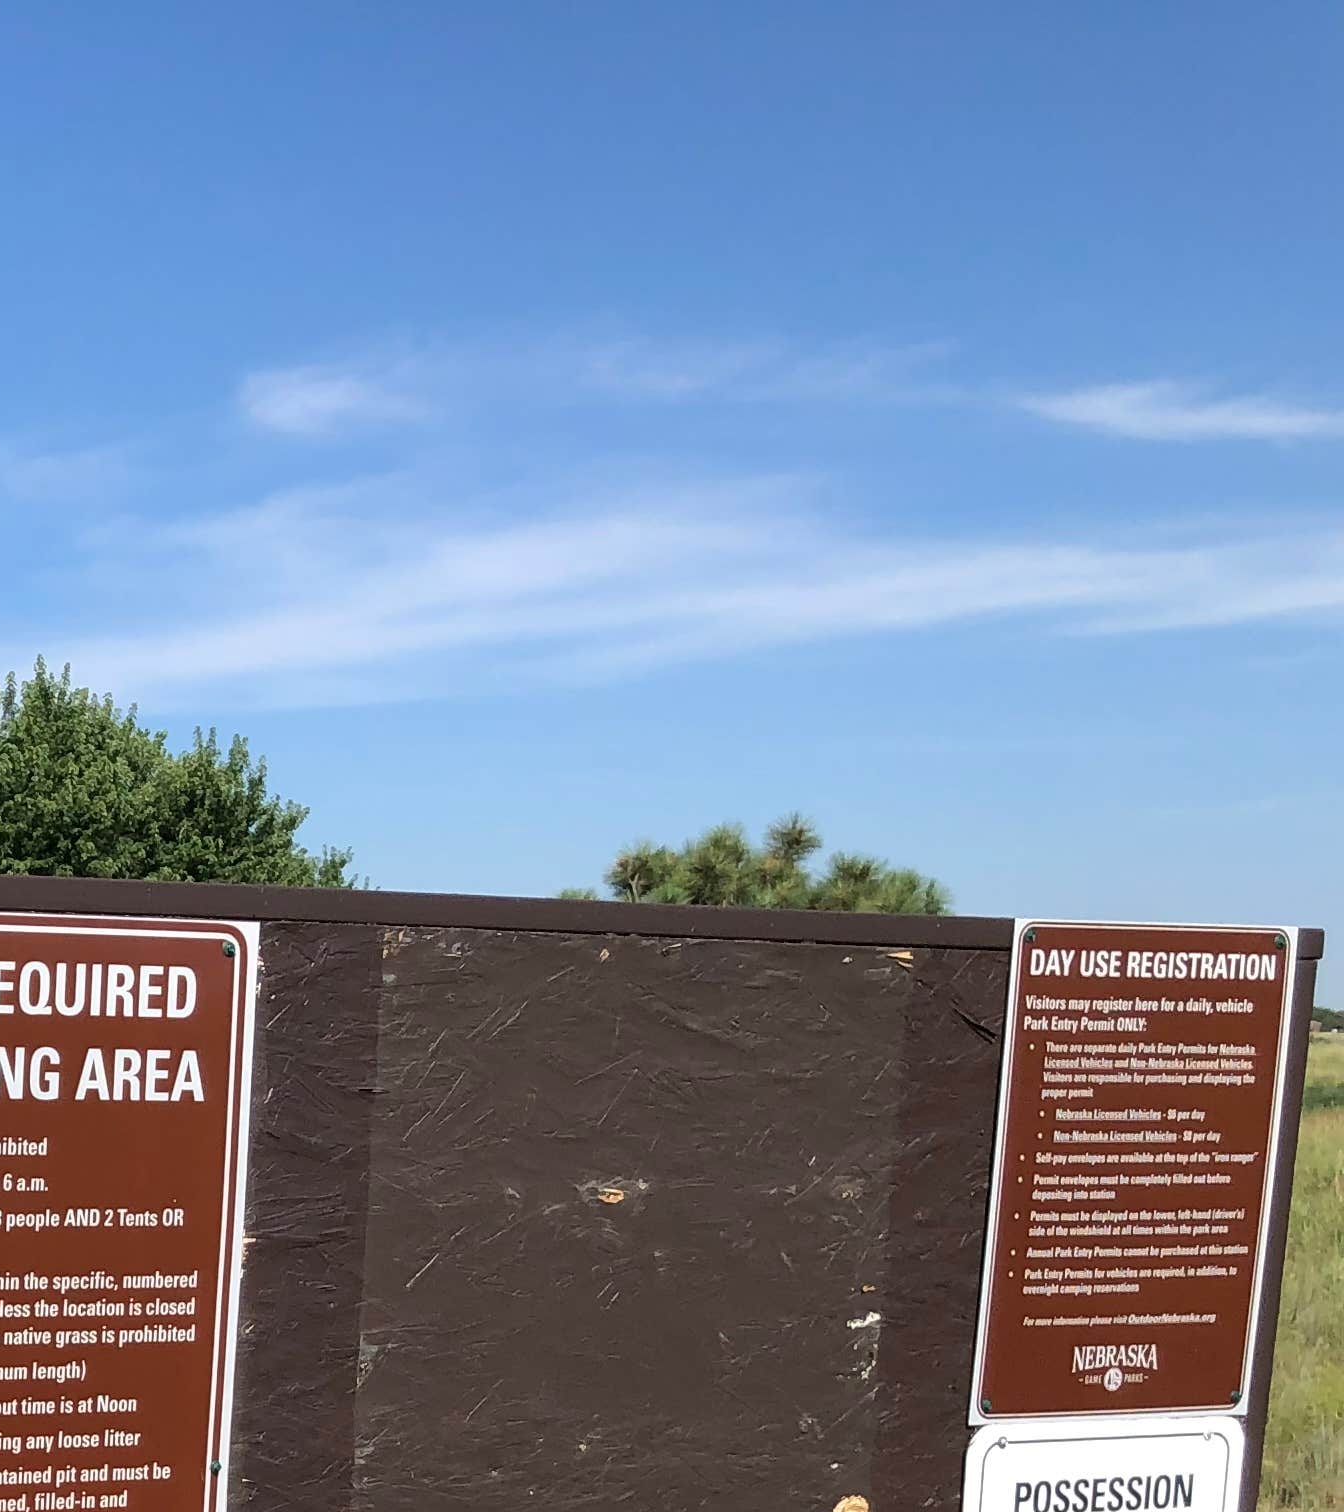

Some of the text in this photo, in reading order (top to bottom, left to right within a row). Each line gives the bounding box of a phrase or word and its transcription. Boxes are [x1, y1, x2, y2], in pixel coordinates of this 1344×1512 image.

[1029, 948, 1276, 980] DAY USE REGISTRATION
[1025, 994, 1253, 1015] Visitors may register here for a daily, vehicle
[1023, 1015, 1147, 1033] Park Entry Permit ONLY:
[1045, 1040, 1256, 1056] There are separate daily Park Entry Permits for Nebraska
[74, 1047, 204, 1102] AREA
[1042, 1070, 1255, 1086] Visitors are responsible for purchasing and displaying the
[1040, 1085, 1094, 1100] proper permit
[2, 1172, 12, 1191] 6
[15, 1177, 48, 1191] a.m.
[5, 1208, 60, 1232] people
[63, 1208, 100, 1227] AND
[103, 1208, 114, 1226] 2
[116, 1208, 158, 1226] Tents
[161, 1207, 184, 1227] OR
[1071, 1343, 1158, 1373] NEBRASKA
[31, 1359, 86, 1383] length)
[1084, 1374, 1103, 1385] GAME
[25, 1435, 54, 1453] any
[57, 1430, 100, 1448] loose
[103, 1428, 141, 1447] litter
